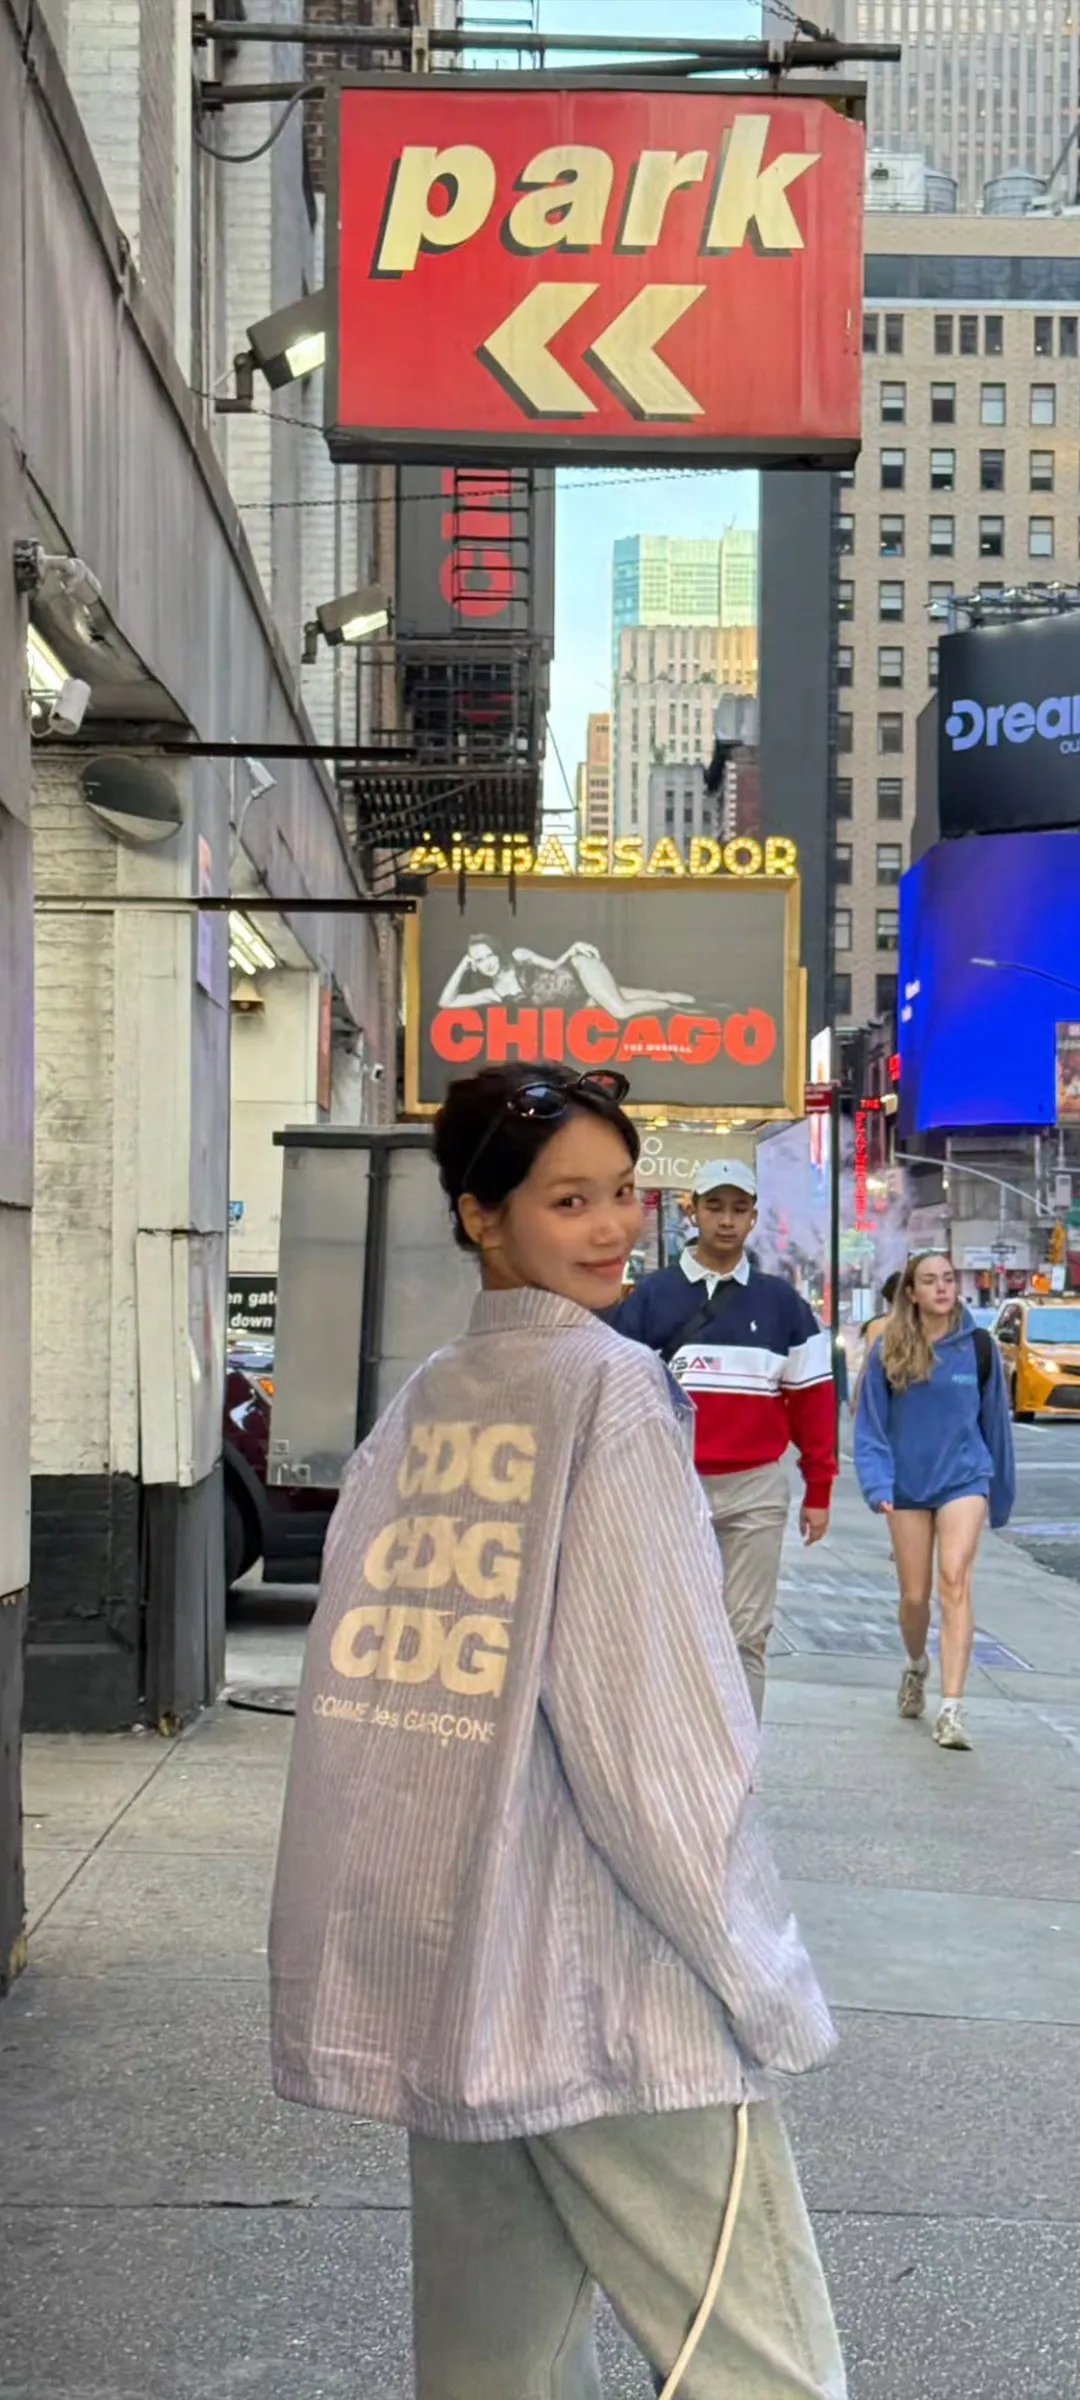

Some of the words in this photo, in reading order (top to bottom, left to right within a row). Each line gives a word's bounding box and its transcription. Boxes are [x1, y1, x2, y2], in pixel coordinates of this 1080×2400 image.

[370, 114, 822, 278] park
[408, 834, 798, 876] AMBASSADOR
[430, 1006, 777, 1066] CHICAGO
[637, 1156, 709, 1179] OTICA
[231, 1313, 273, 1328] down
[397, 1422, 537, 1504] CDG
[364, 1515, 524, 1601] CDG
[330, 1605, 514, 1698] CDG
